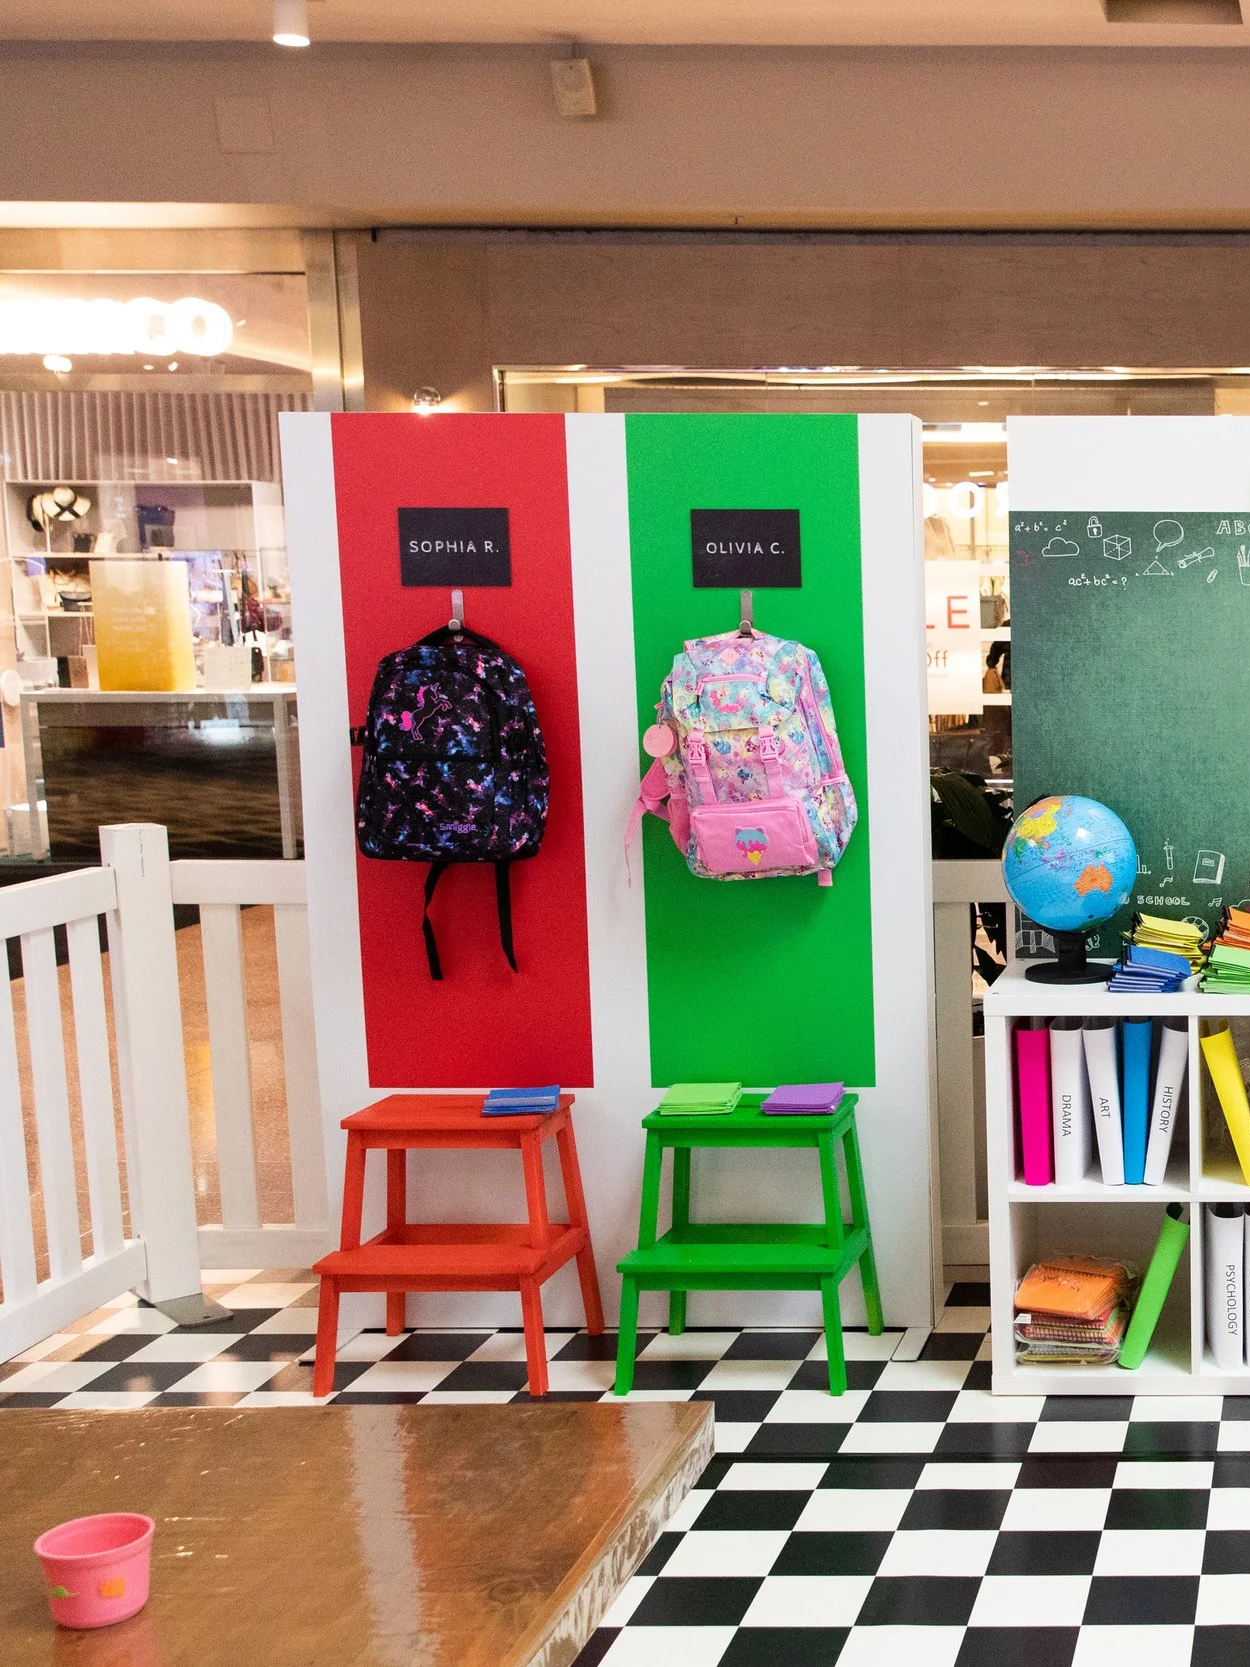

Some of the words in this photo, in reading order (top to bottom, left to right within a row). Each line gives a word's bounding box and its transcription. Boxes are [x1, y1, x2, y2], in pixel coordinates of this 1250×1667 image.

[409, 540, 477, 553] SOPHIA
[485, 540, 500, 553] R.
[706, 542, 764, 554] OLIVIA
[770, 543, 785, 554] C.
[1137, 895, 1190, 906] SCHOOL
[1061, 1094, 1072, 1138] DRAMA
[1099, 1097, 1111, 1119] ART
[1158, 1085, 1174, 1134] HISTORY
[1225, 1264, 1239, 1337] PSYCHOLOGY
